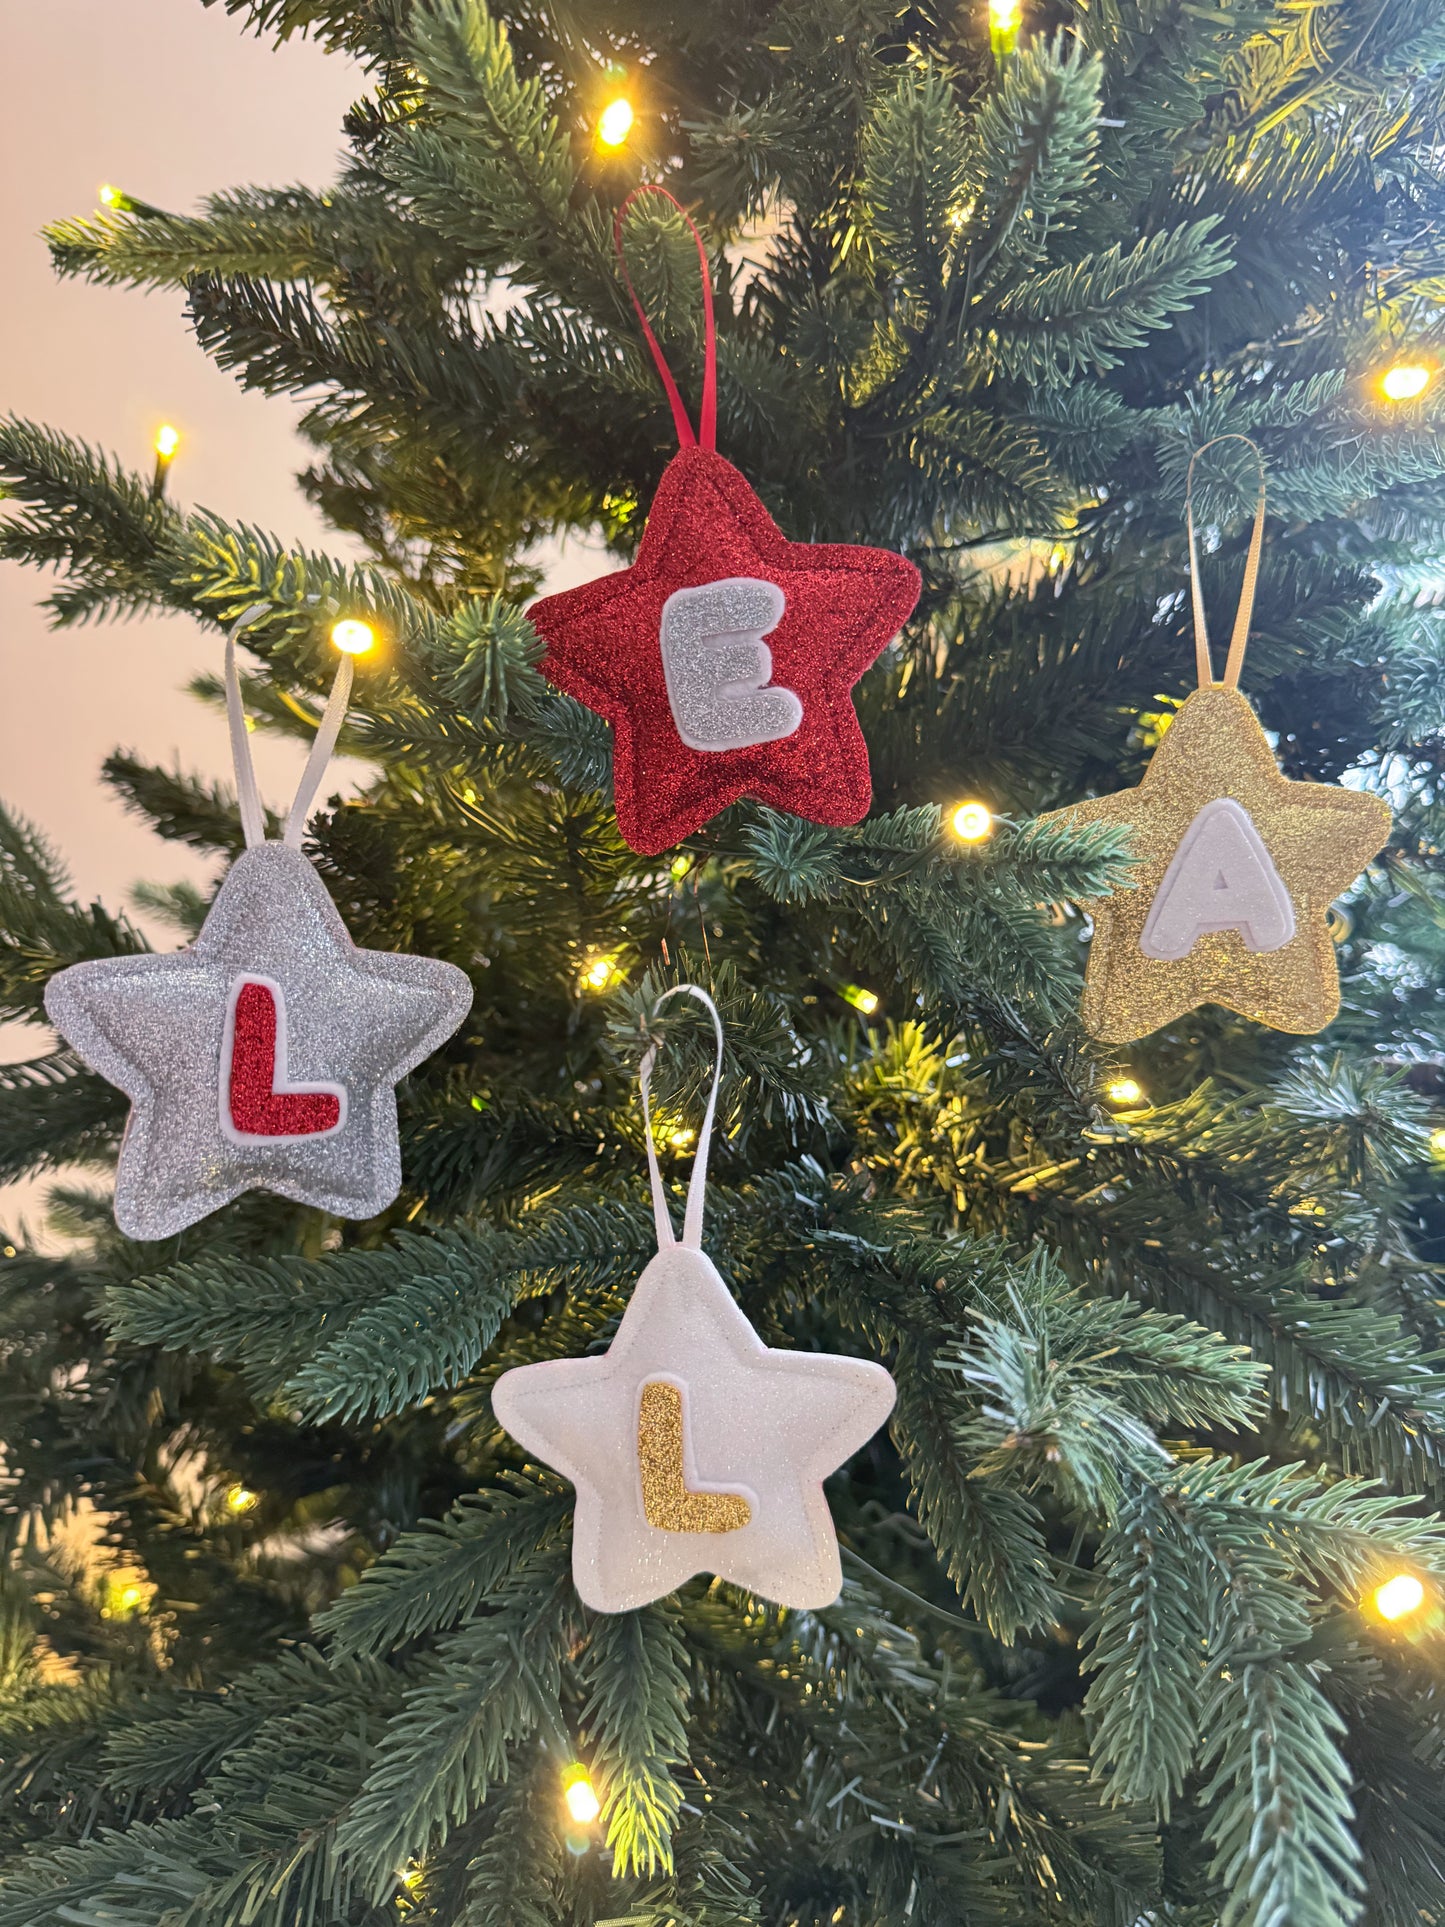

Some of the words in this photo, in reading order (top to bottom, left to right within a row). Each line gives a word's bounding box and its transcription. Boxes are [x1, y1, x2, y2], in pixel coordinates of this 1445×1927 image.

[661, 578, 803, 752] E
[1139, 798, 1295, 960] A
[220, 974, 346, 1144] L
[635, 1374, 758, 1534] L
